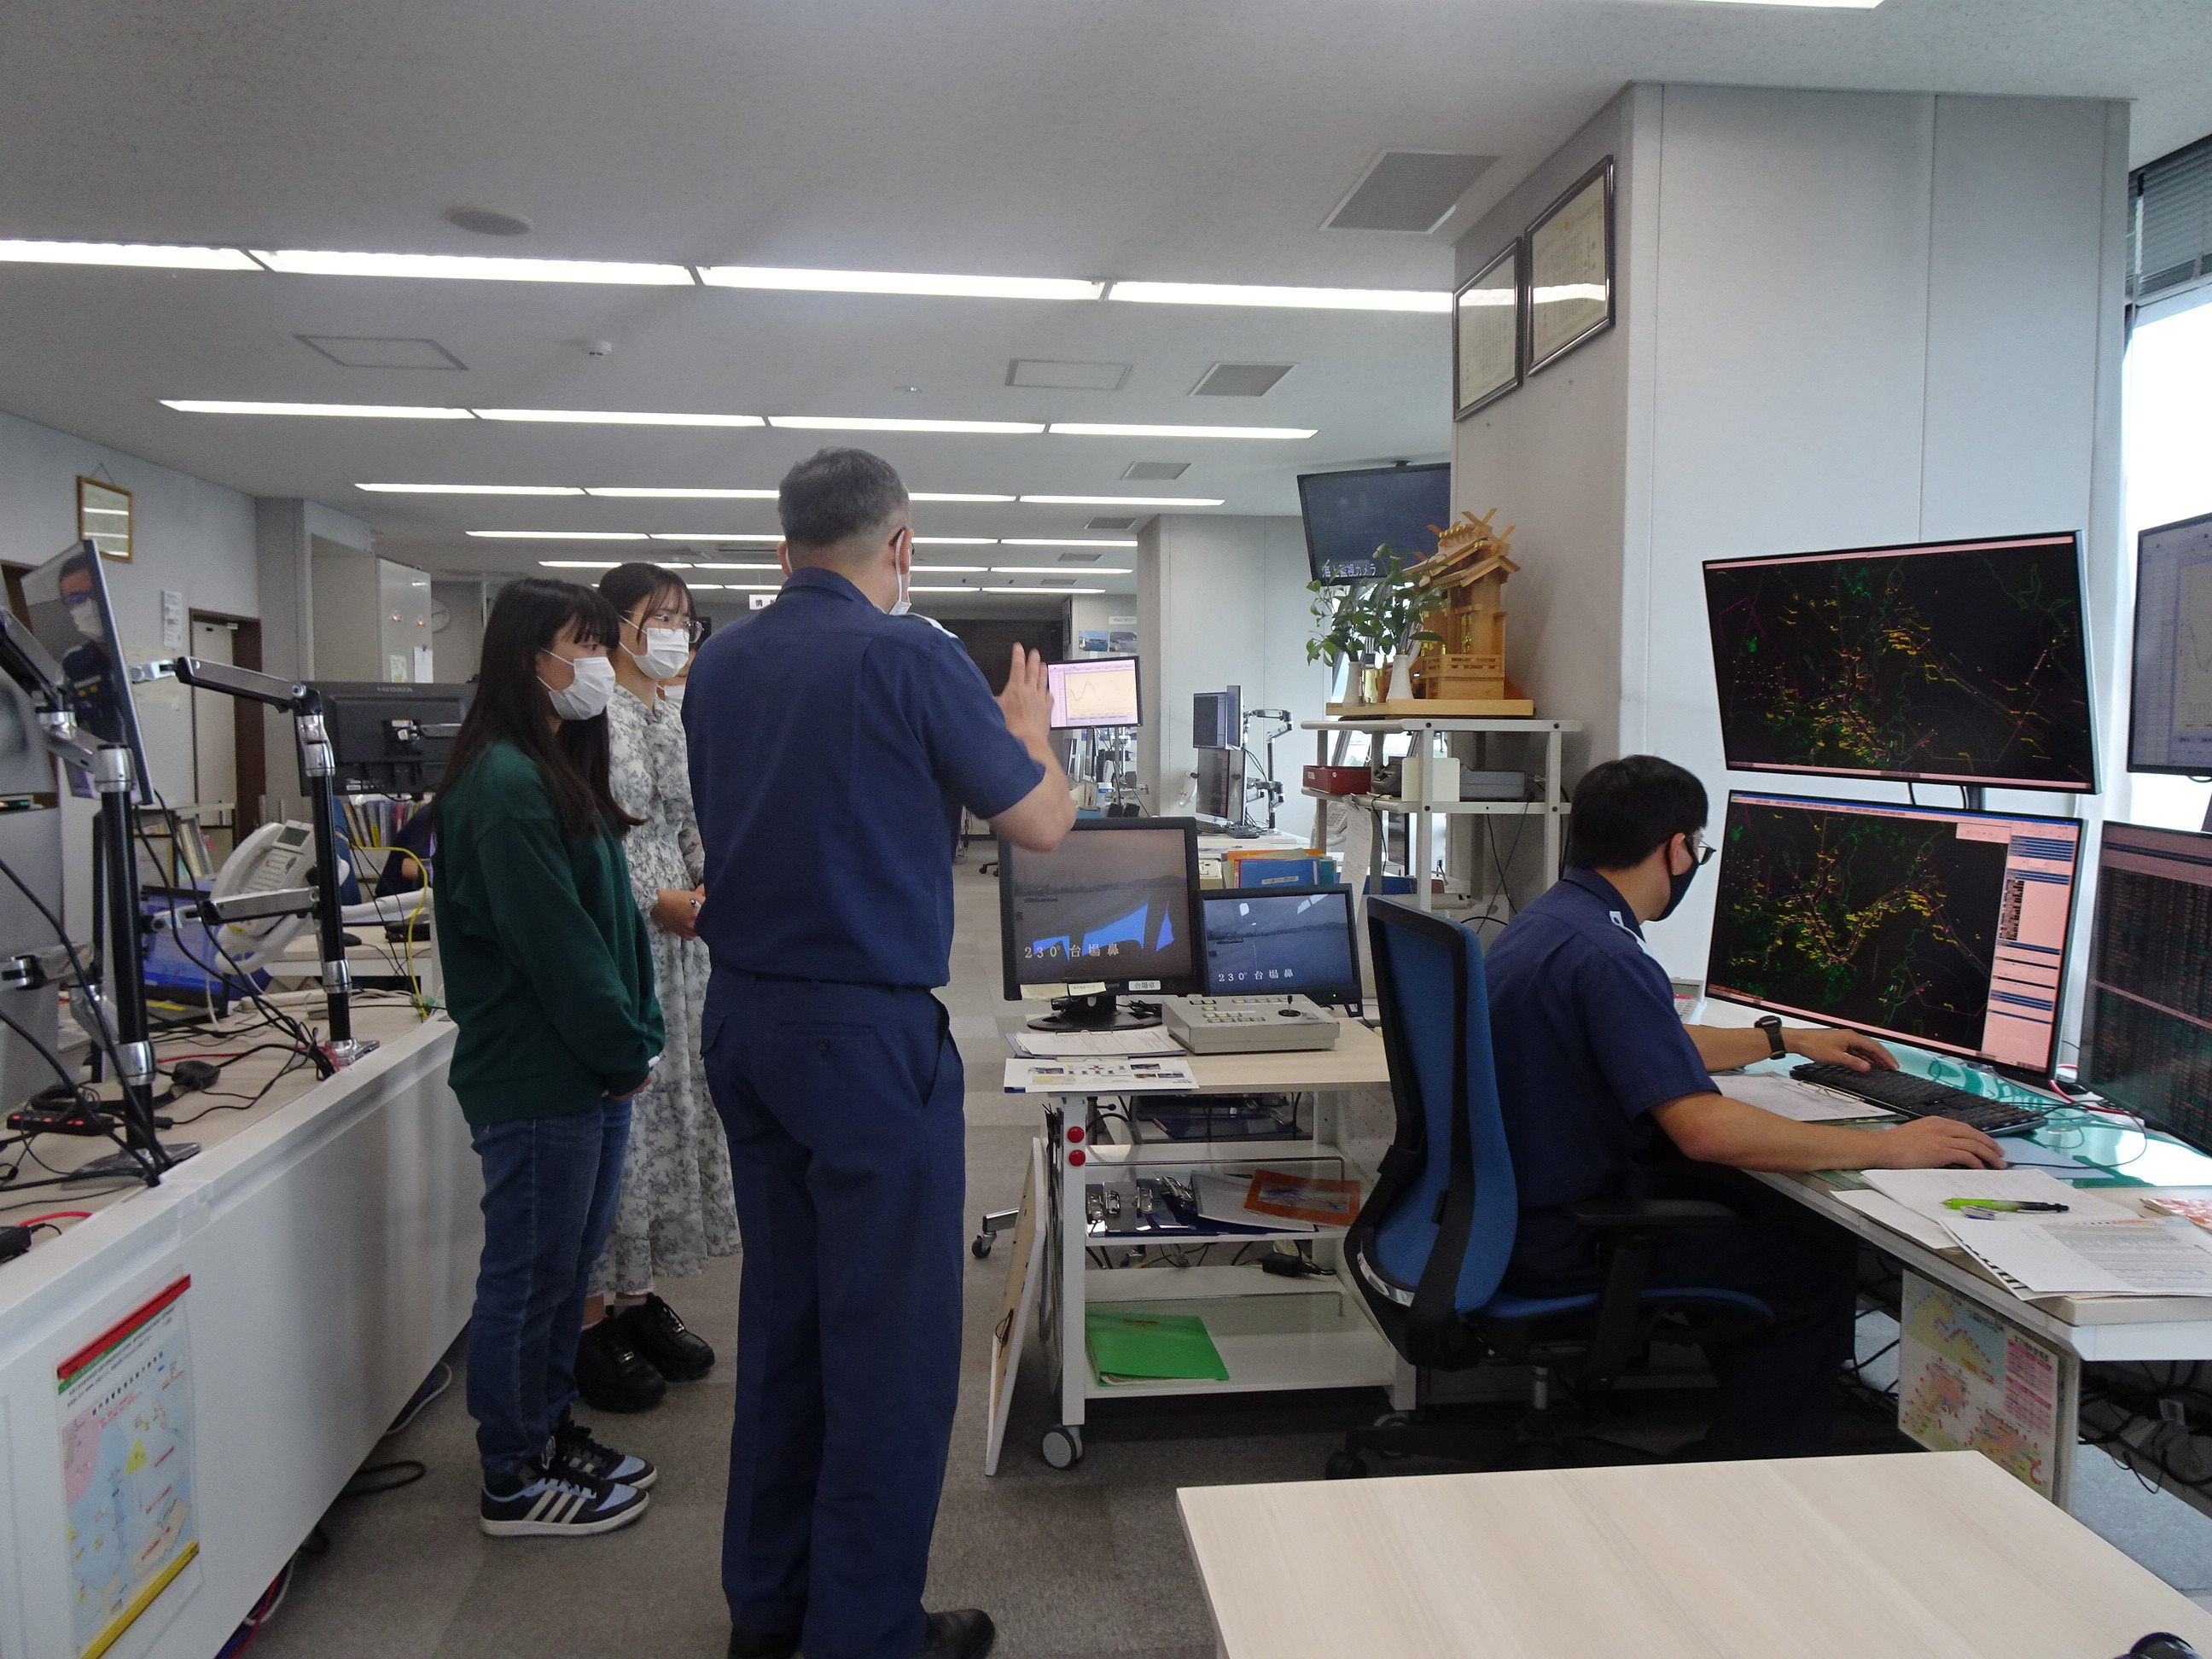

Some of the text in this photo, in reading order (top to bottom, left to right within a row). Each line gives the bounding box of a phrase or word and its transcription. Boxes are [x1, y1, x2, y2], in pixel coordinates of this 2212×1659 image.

[1069, 943, 1120, 958] 台場鼻
[1254, 968, 1295, 981] 台場鼻
